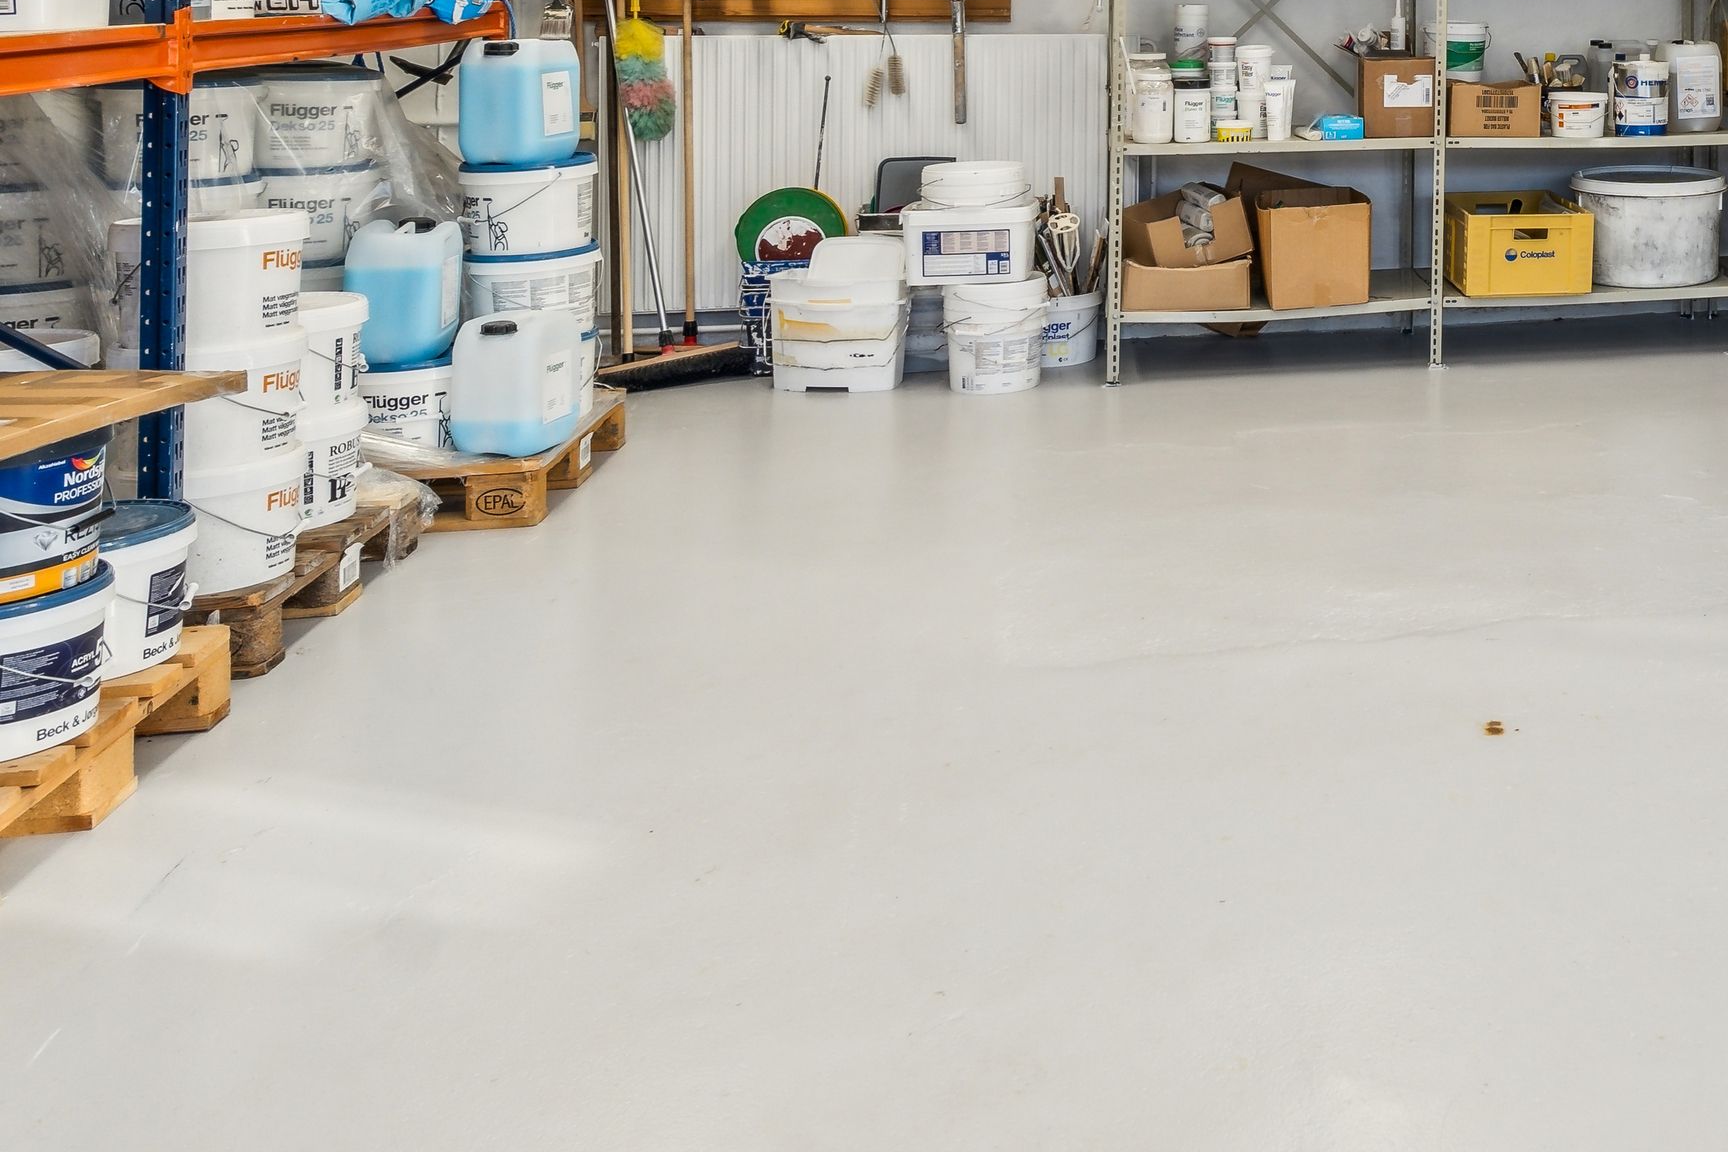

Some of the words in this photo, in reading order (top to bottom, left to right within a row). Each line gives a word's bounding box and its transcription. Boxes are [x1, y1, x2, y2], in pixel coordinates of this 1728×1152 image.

[270, 103, 338, 119] Flügger
[1520, 250, 1555, 260] Coloplast
[262, 294, 276, 304] Mat
[363, 394, 429, 412] Flügger
[484, 494, 519, 510] EPAL
[62, 552, 78, 562] EASY
[143, 641, 167, 660] Beck
[169, 638, 175, 649] &
[37, 720, 69, 741] Beck
[72, 715, 80, 727] &
